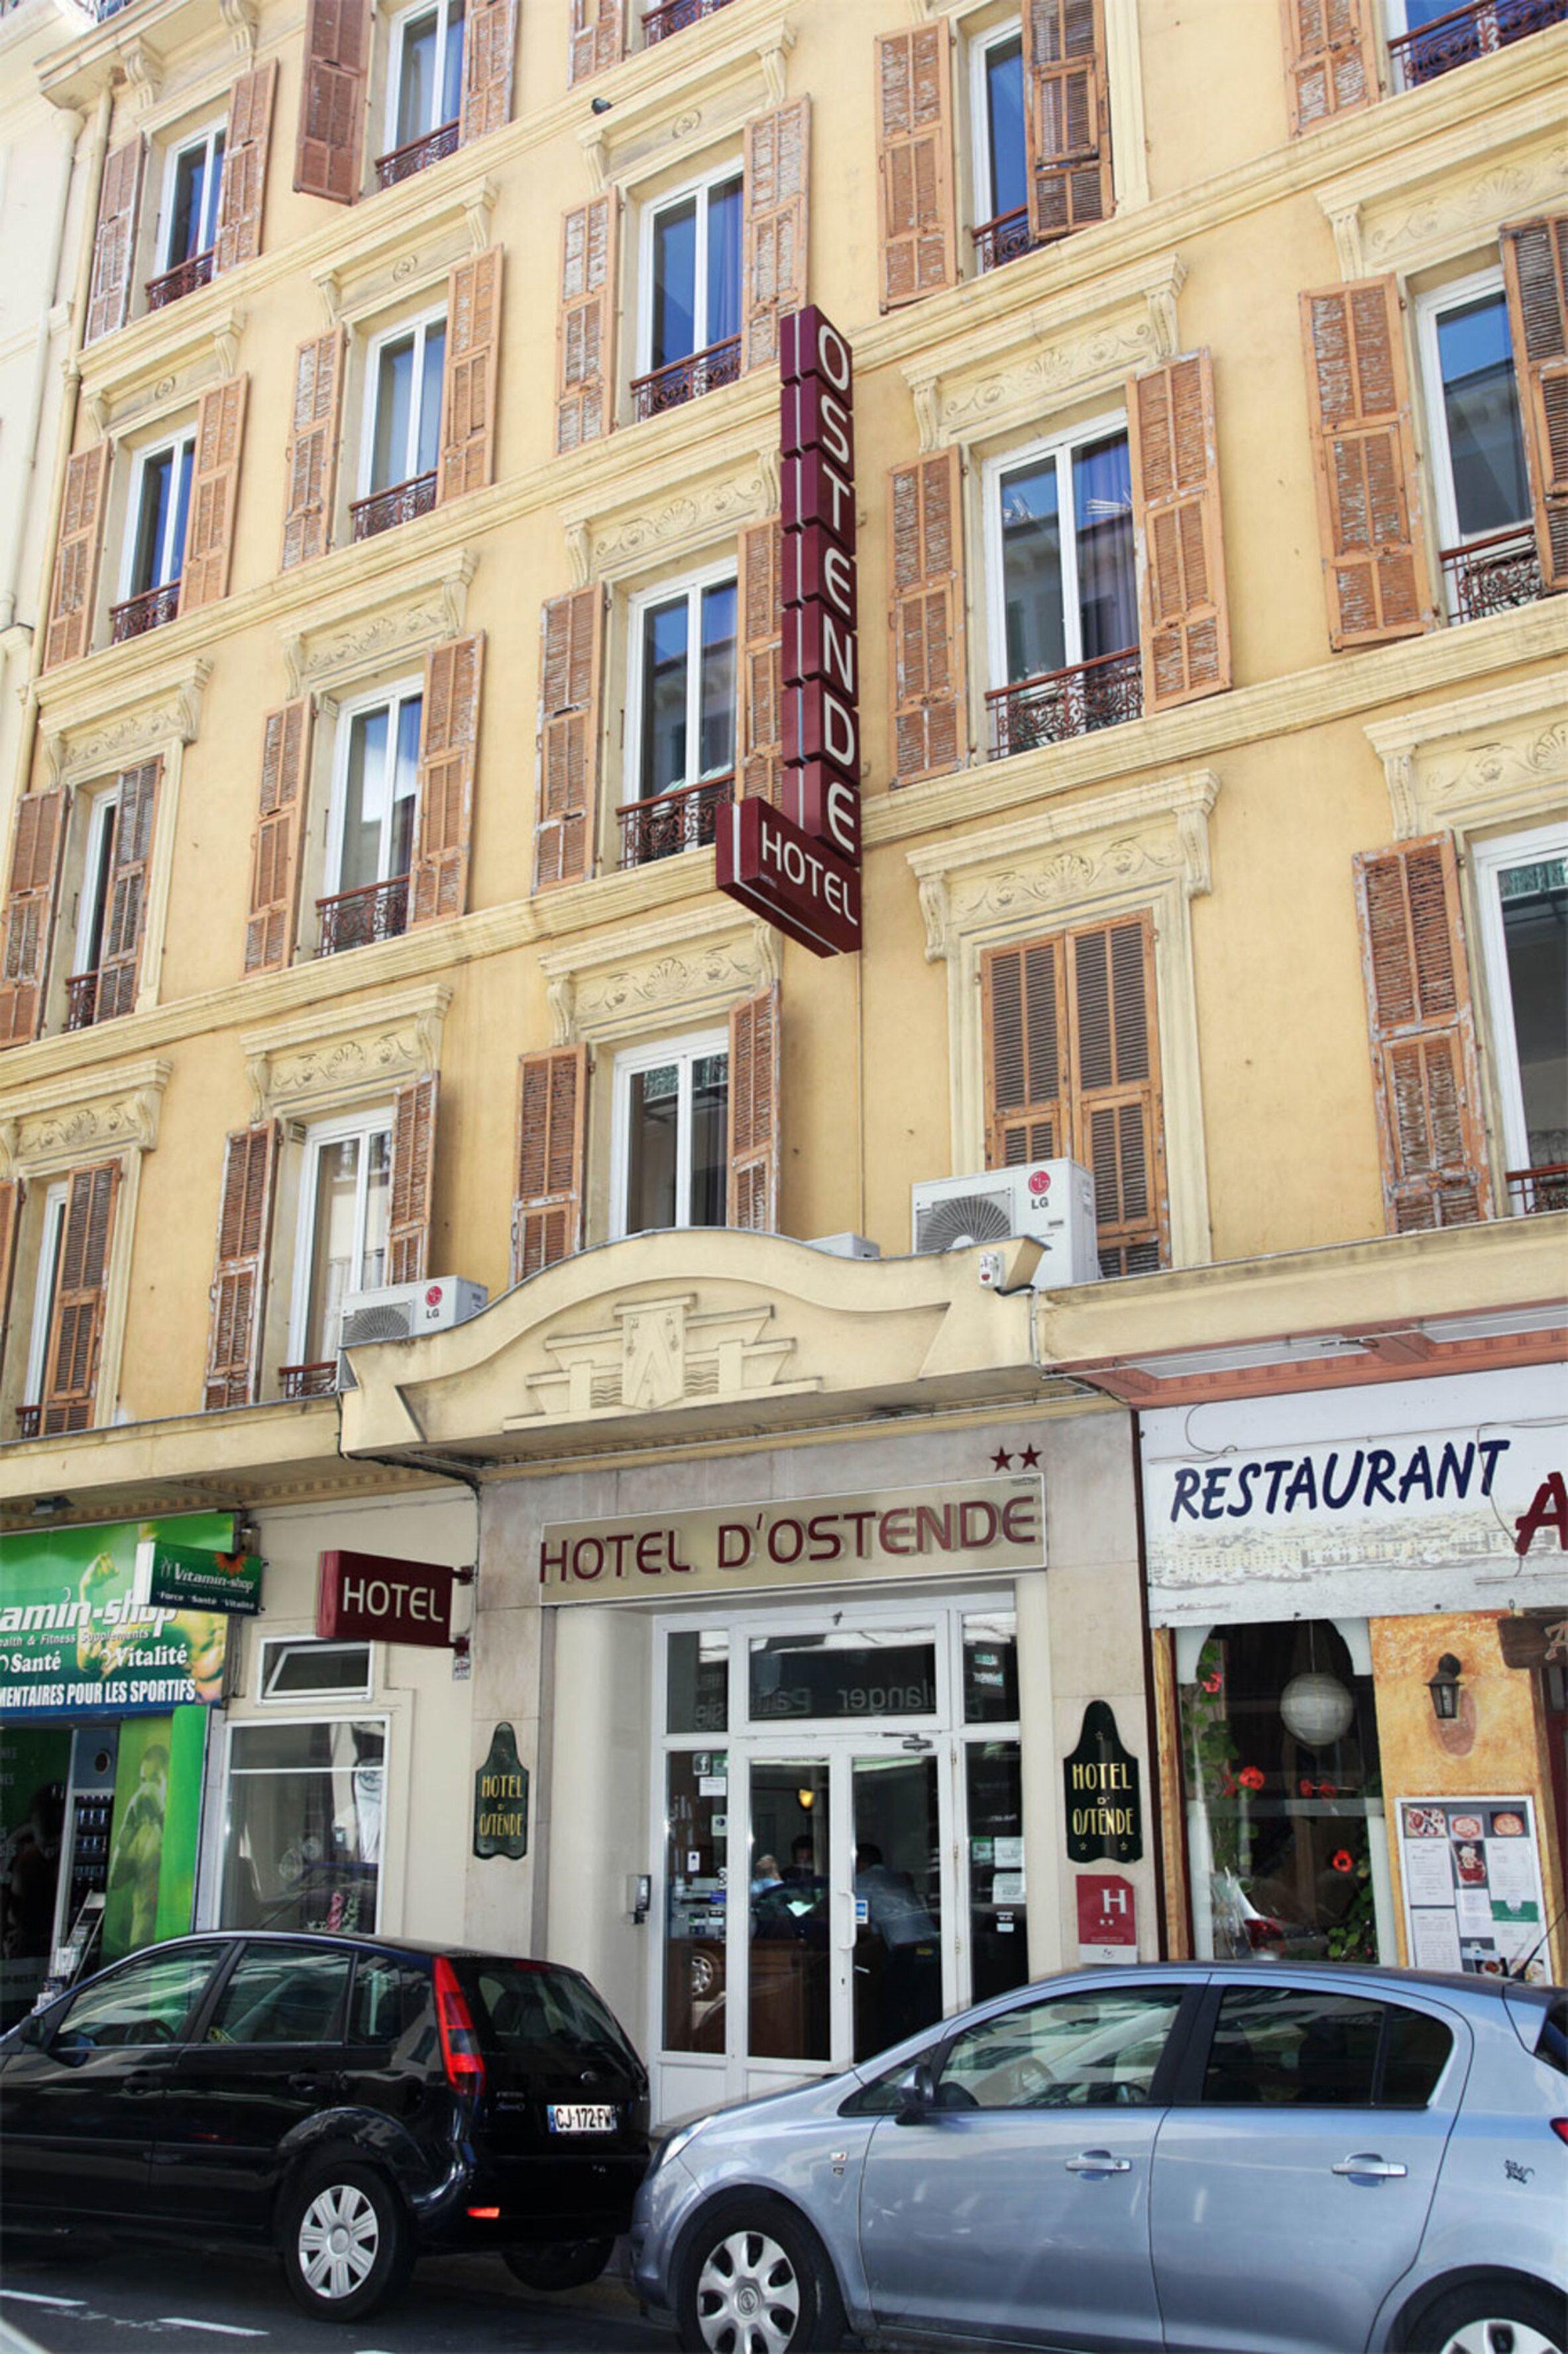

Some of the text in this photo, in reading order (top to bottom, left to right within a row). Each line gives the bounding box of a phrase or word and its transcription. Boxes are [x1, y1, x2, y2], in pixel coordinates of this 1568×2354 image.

[818, 324, 855, 854] OSTENDE
[762, 821, 858, 926] HOTEL
[1031, 1197, 1049, 1209] LG
[426, 1308, 439, 1319] LG
[1170, 1439, 1510, 1523] RESTAURANT
[540, 1496, 1036, 1583] HOTEL D'OSTENDE
[174, 1562, 254, 1594] Vitamin-shop
[160, 1591, 184, 1602] Force
[191, 1594, 217, 1605] Santé
[343, 1577, 444, 1622] HOTEL
[0, 1587, 178, 1637] amin-shop
[27, 1635, 36, 1645] &
[40, 1633, 76, 1645] Fitness
[10, 1651, 61, 1673] Santé
[114, 1643, 188, 1667] Vitalité
[67, 1682, 103, 1705] POUR
[105, 1681, 128, 1704] LES
[129, 1678, 196, 1704] SPORTIFS
[482, 1775, 523, 1797] HOTEL
[1073, 1763, 1132, 1789] HOTEL
[478, 1812, 523, 1836] OSTENDE
[1073, 1808, 1134, 1836] OSTENDE
[1102, 1889, 1127, 1914] H
